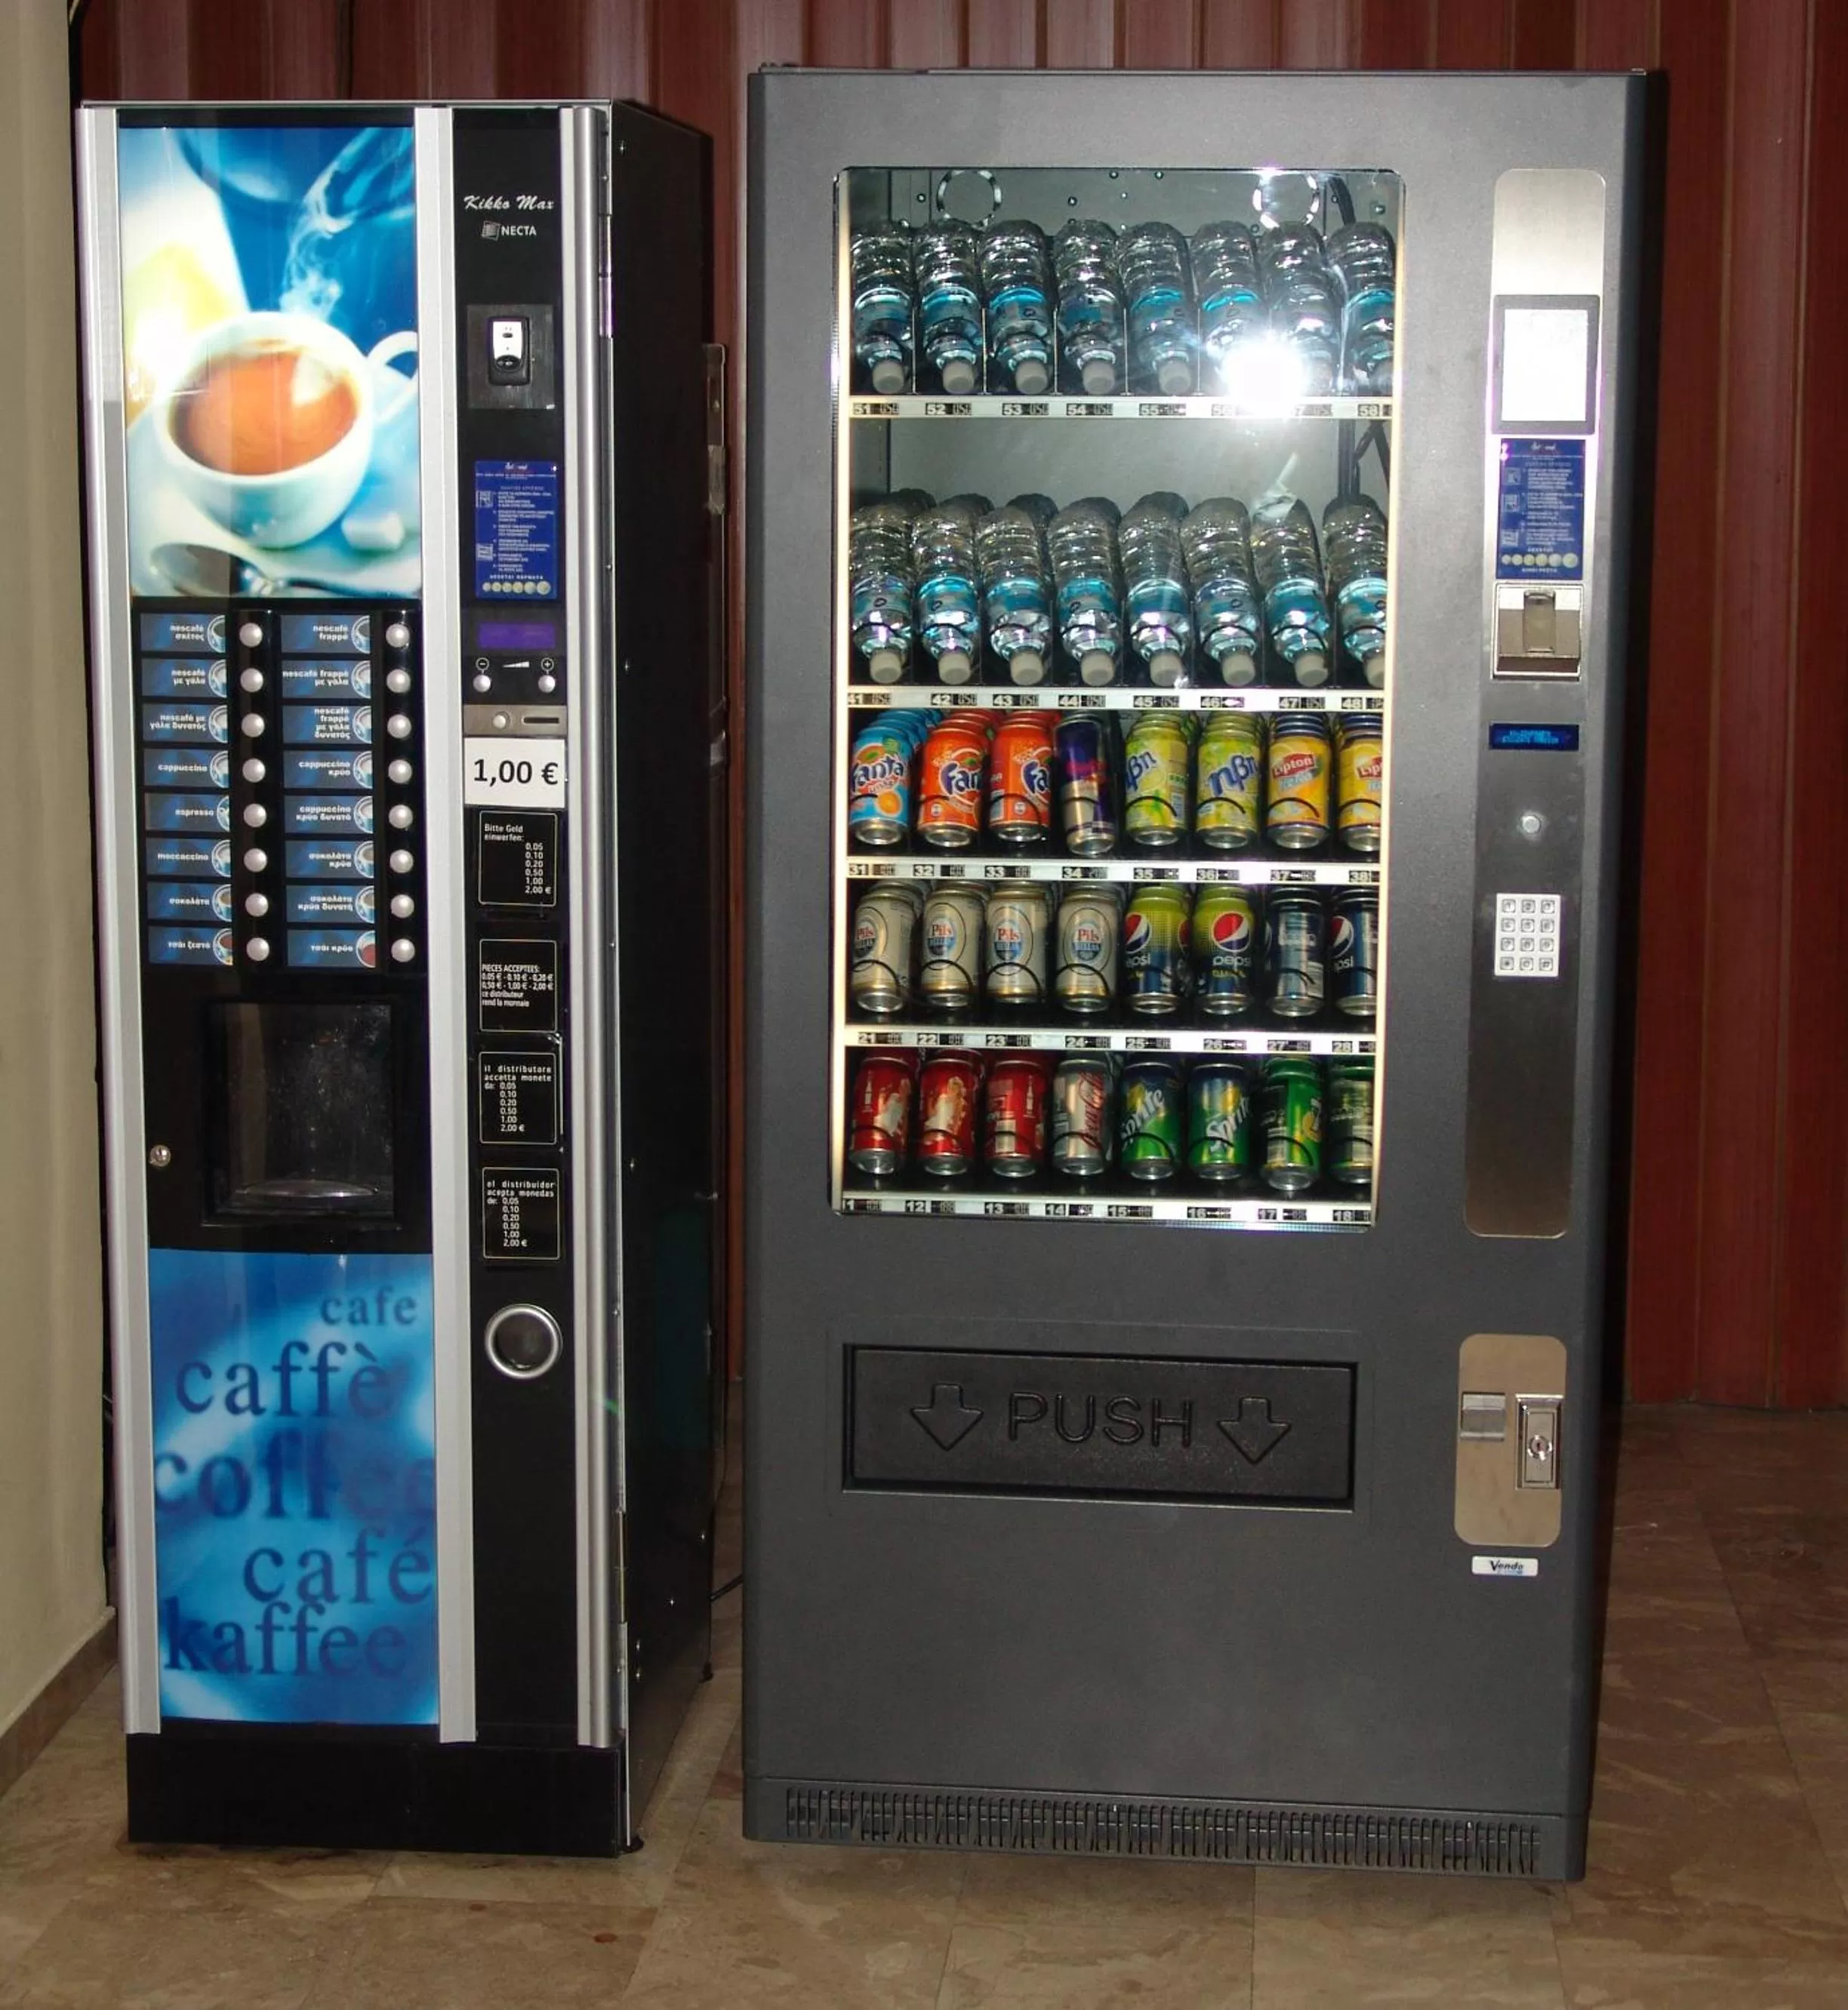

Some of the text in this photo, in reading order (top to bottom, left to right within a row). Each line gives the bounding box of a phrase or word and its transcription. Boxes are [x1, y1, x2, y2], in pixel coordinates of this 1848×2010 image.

[464, 194, 554, 210] Kikko Max
[501, 226, 537, 235] NECTA
[853, 403, 870, 415] 51
[927, 404, 946, 415] 52
[1003, 404, 1022, 415] 53
[1067, 404, 1086, 416] 54
[932, 694, 951, 706] 42
[993, 694, 1013, 706] 43
[1059, 695, 1078, 706] 44
[1134, 696, 1153, 708] 45
[1201, 697, 1221, 708] 46
[1280, 697, 1299, 709] 47
[1342, 697, 1362, 709] 48
[1274, 756, 1314, 776] Lipton
[473, 759, 558, 786] 1,00 €
[941, 762, 981, 795] Fan
[300, 805, 352, 814] cappuccino
[485, 823, 523, 833] Bitte Geld
[850, 864, 867, 876] 31
[914, 864, 934, 876] 32
[985, 865, 1005, 878] 33
[1063, 867, 1082, 879] 34
[1134, 868, 1153, 879] 35
[1197, 869, 1216, 880] 36
[1270, 870, 1290, 882] 37
[1350, 870, 1369, 882] 38
[857, 927, 874, 940] Pils
[932, 924, 952, 937] Pils
[997, 927, 1020, 940] Pils
[1078, 928, 1100, 941] Pils
[858, 1032, 875, 1044] 21
[918, 1033, 938, 1045] 22
[987, 1035, 1006, 1046] 23
[1066, 1036, 1085, 1048] 24
[1126, 1037, 1144, 1048] 25
[502, 1180, 556, 1189] distribuidor
[906, 1200, 926, 1212] 12
[985, 1202, 1004, 1214] 13
[1046, 1204, 1065, 1216] 14
[1109, 1205, 1128, 1217] 15
[1187, 1207, 1206, 1219] 16
[1258, 1208, 1277, 1220] 17
[1334, 1210, 1352, 1222] 18
[175, 1341, 396, 1419] caffè
[1008, 1391, 1193, 1448] PUSH
[243, 1526, 433, 1605] café
[164, 1596, 408, 1678] kaffee
